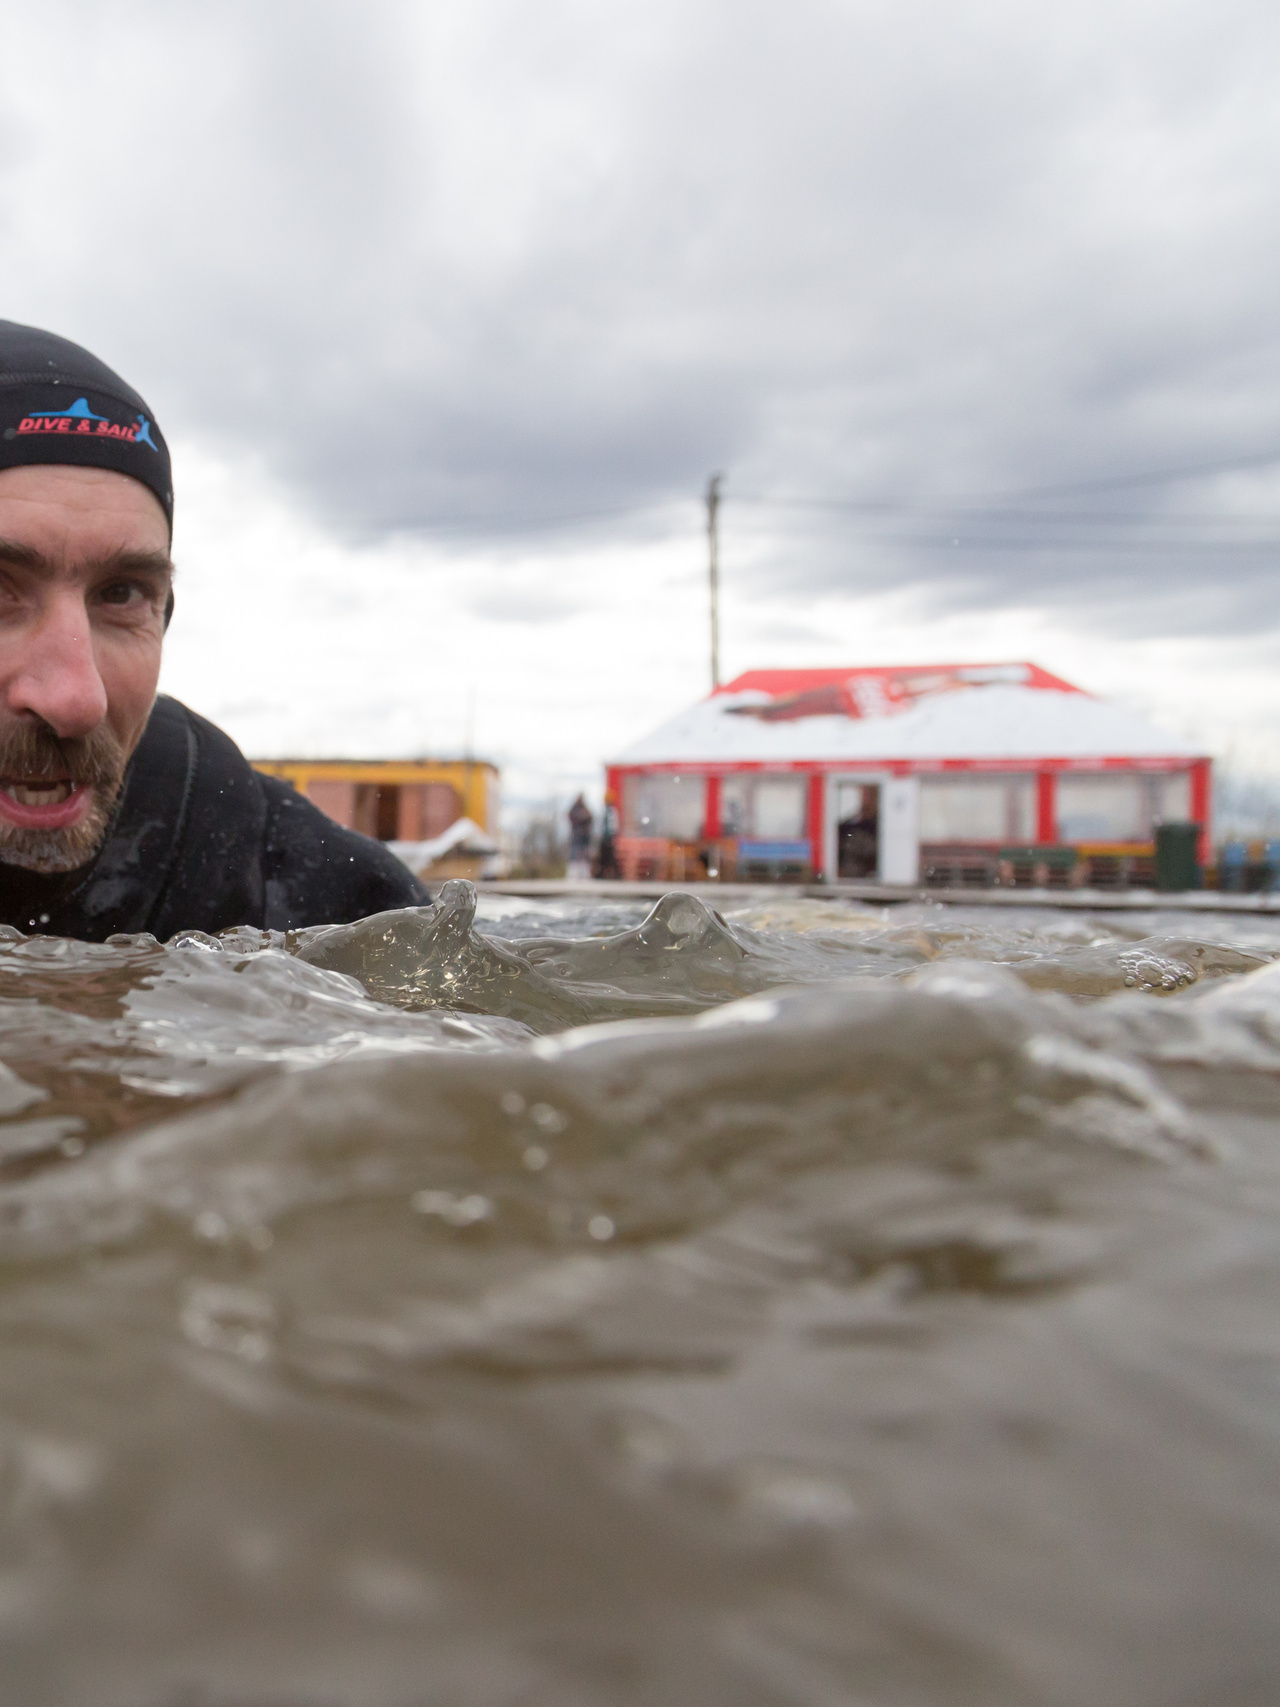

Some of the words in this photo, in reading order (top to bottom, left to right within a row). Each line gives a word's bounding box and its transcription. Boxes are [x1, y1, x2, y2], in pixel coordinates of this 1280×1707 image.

[18, 417, 71, 431] DIVE
[76, 419, 91, 432] &
[96, 420, 136, 440] SAIL
